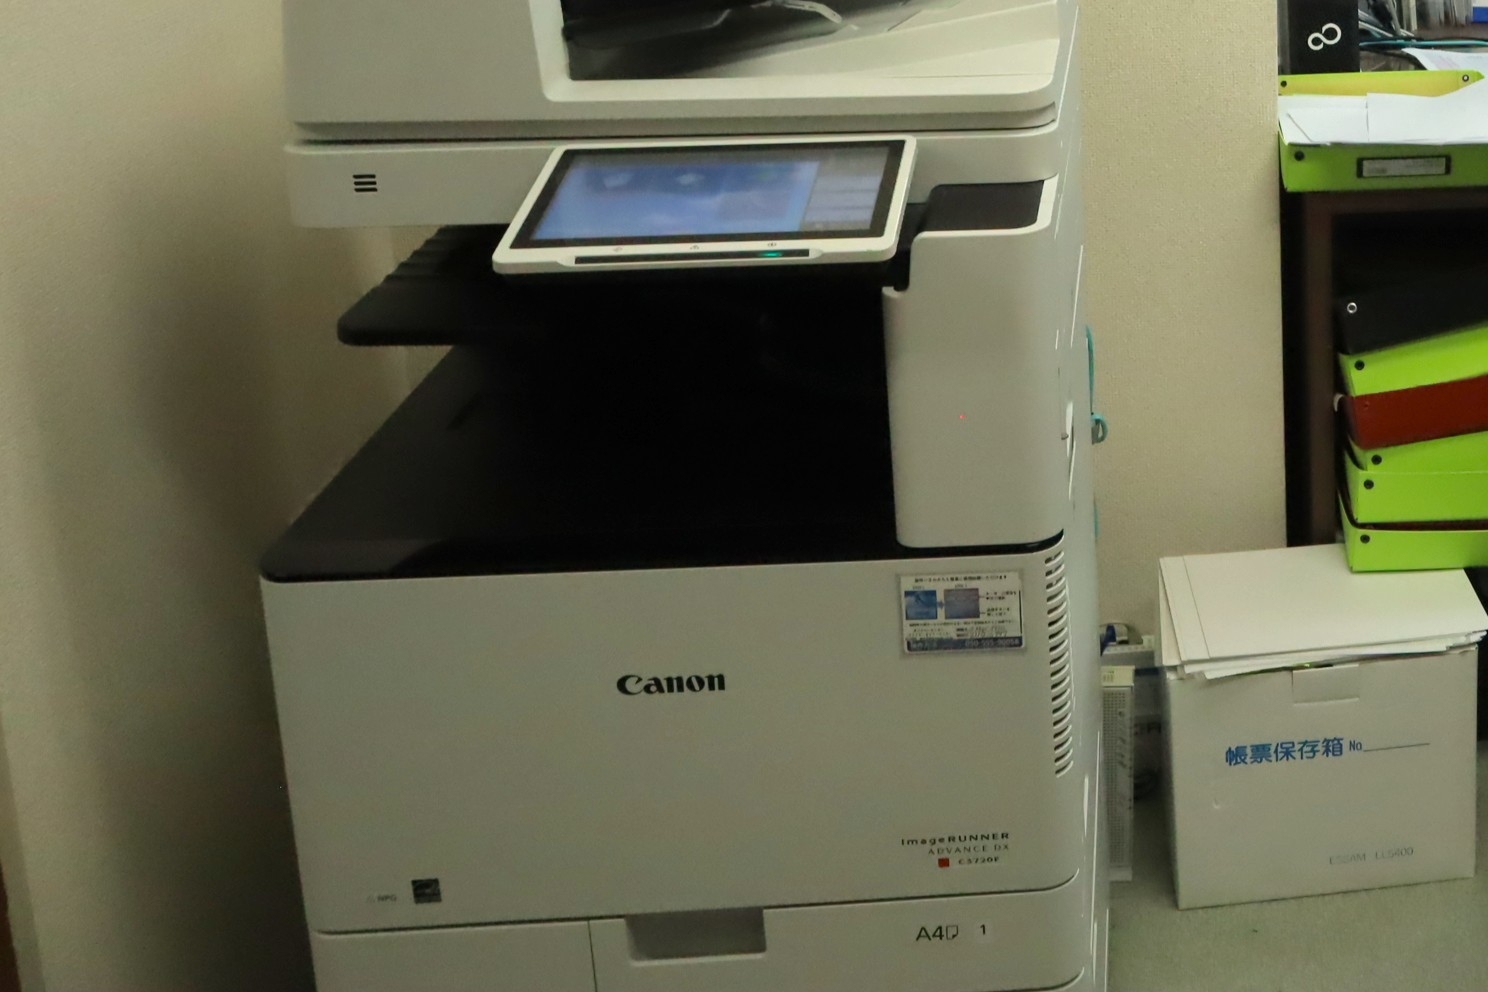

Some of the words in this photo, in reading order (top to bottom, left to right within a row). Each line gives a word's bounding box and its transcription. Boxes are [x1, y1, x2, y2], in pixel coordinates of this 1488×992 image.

[616, 673, 726, 696] Canon
[1225, 736, 1344, 766] 帳票保存箱
[928, 844, 989, 856] ADVANCE
[916, 925, 945, 942] A4
[980, 924, 986, 936] 1
